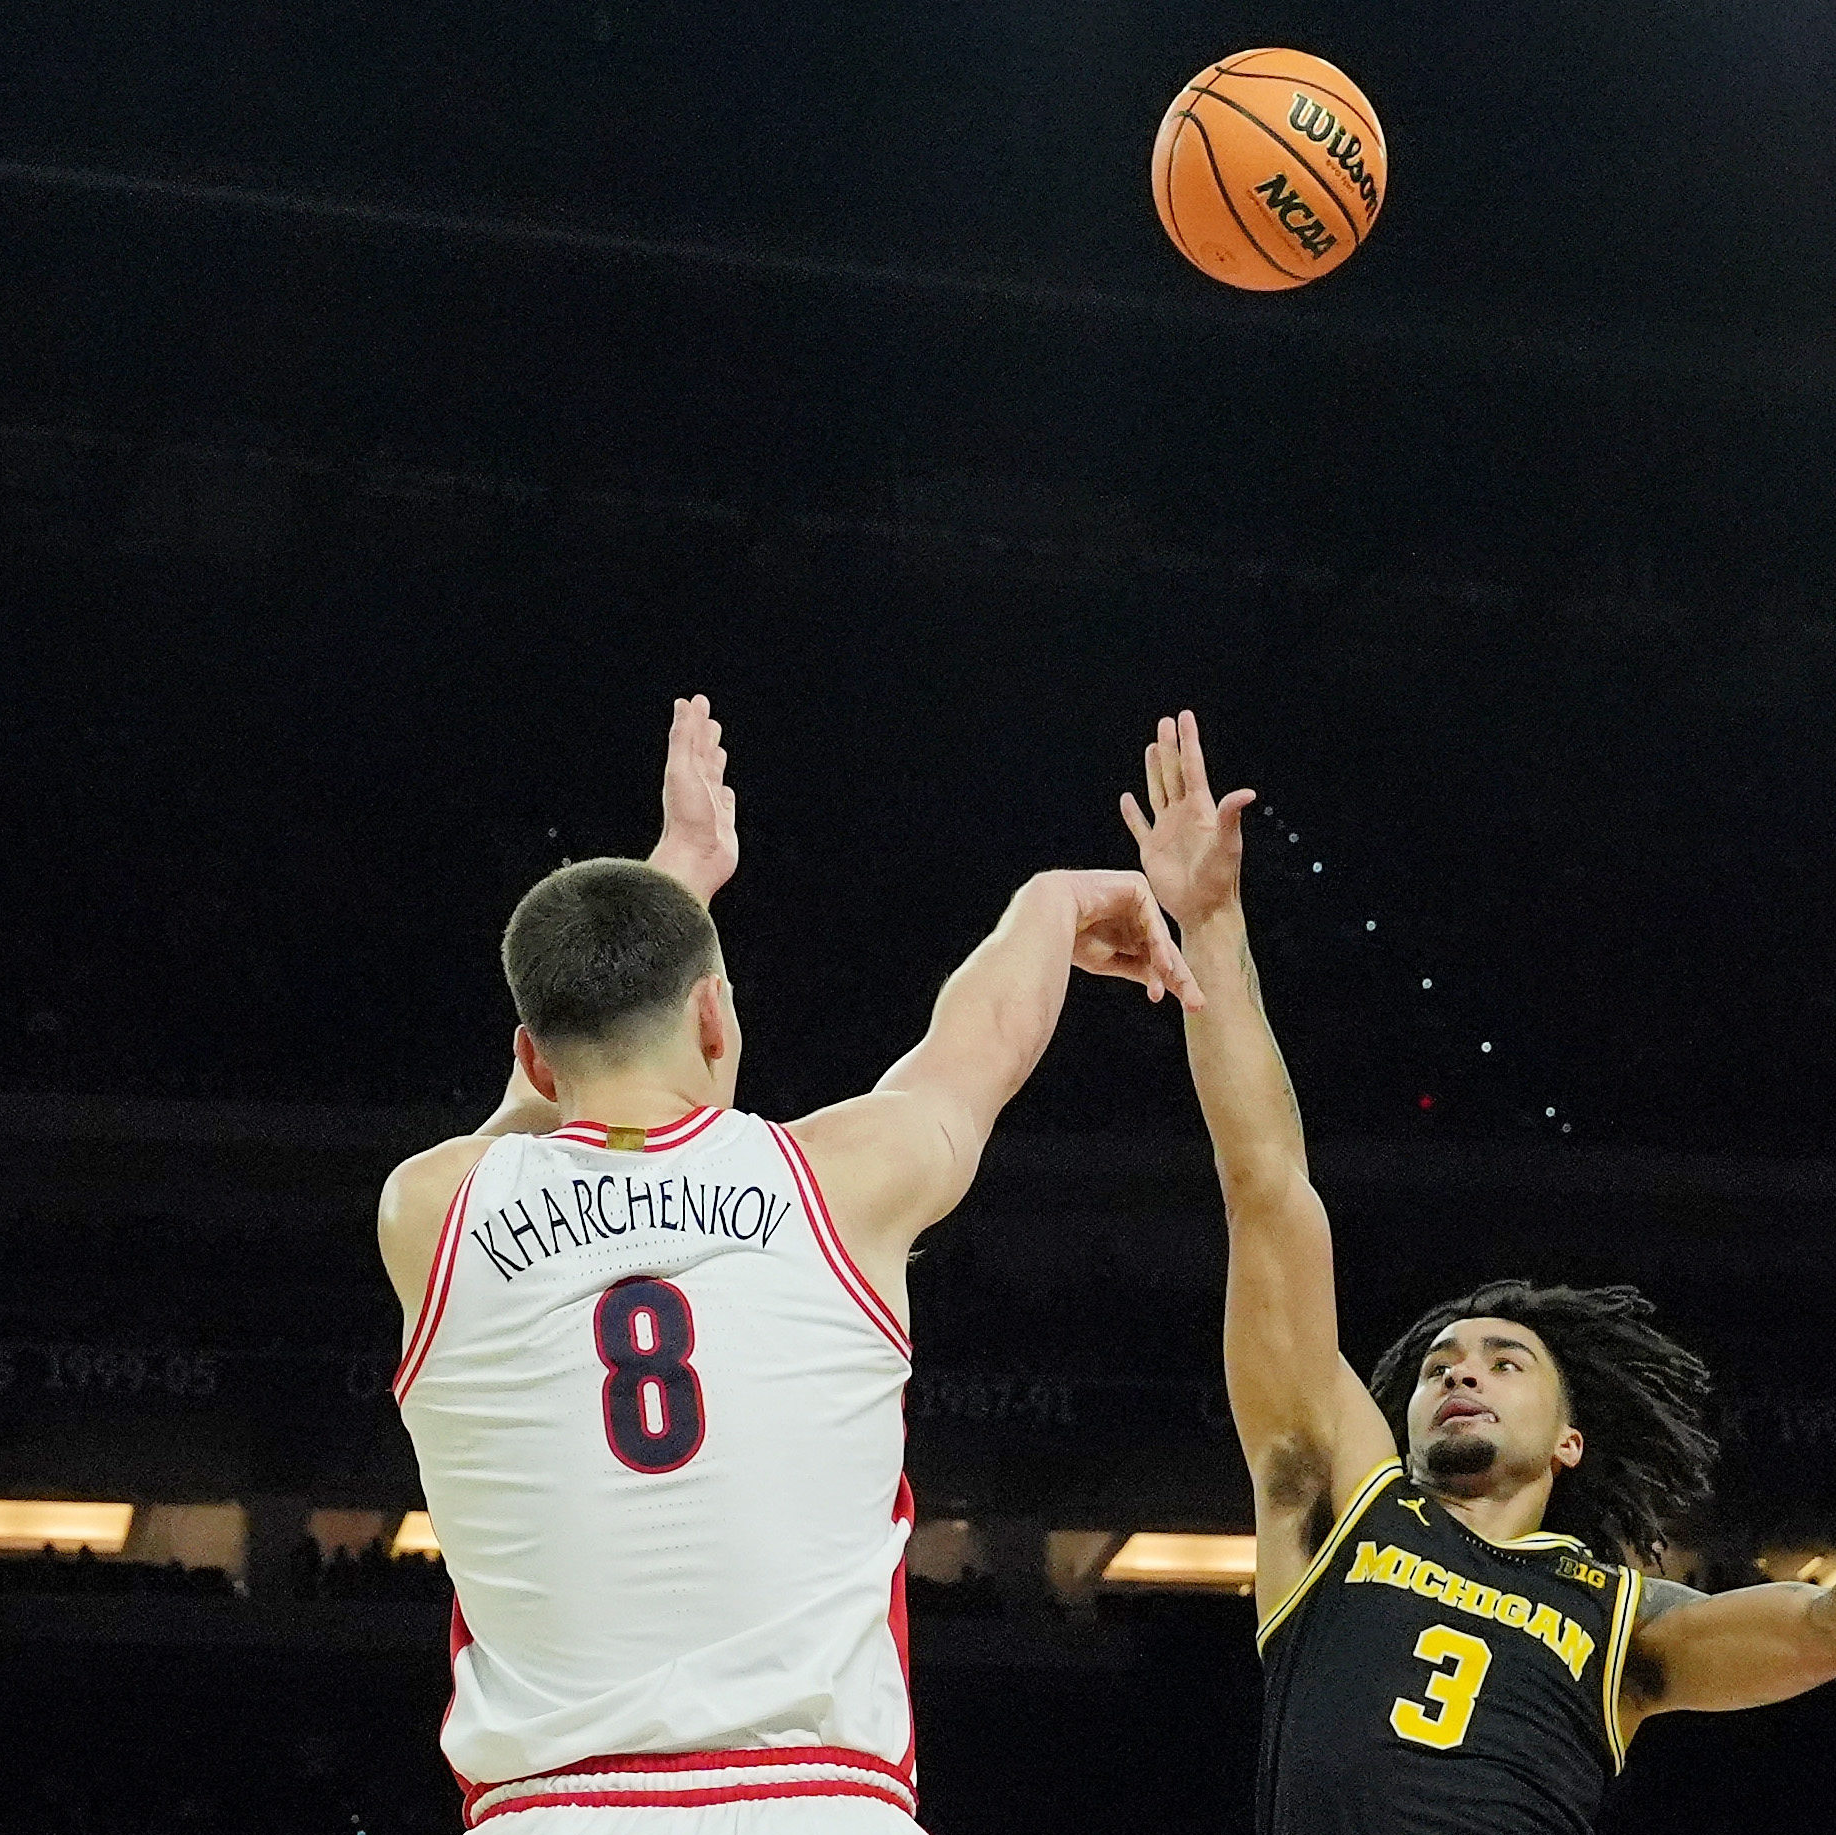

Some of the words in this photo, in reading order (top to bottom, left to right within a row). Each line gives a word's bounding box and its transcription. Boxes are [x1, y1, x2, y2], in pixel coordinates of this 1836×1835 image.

[1254, 172, 1338, 260] NCAA
[1288, 92, 1381, 221] Wilson
[470, 1174, 792, 1283] KHARCHENKOV
[593, 1275, 706, 1475] 8
[1344, 1540, 1596, 1682] MICHIGAN
[1389, 1624, 1493, 1751] 3
